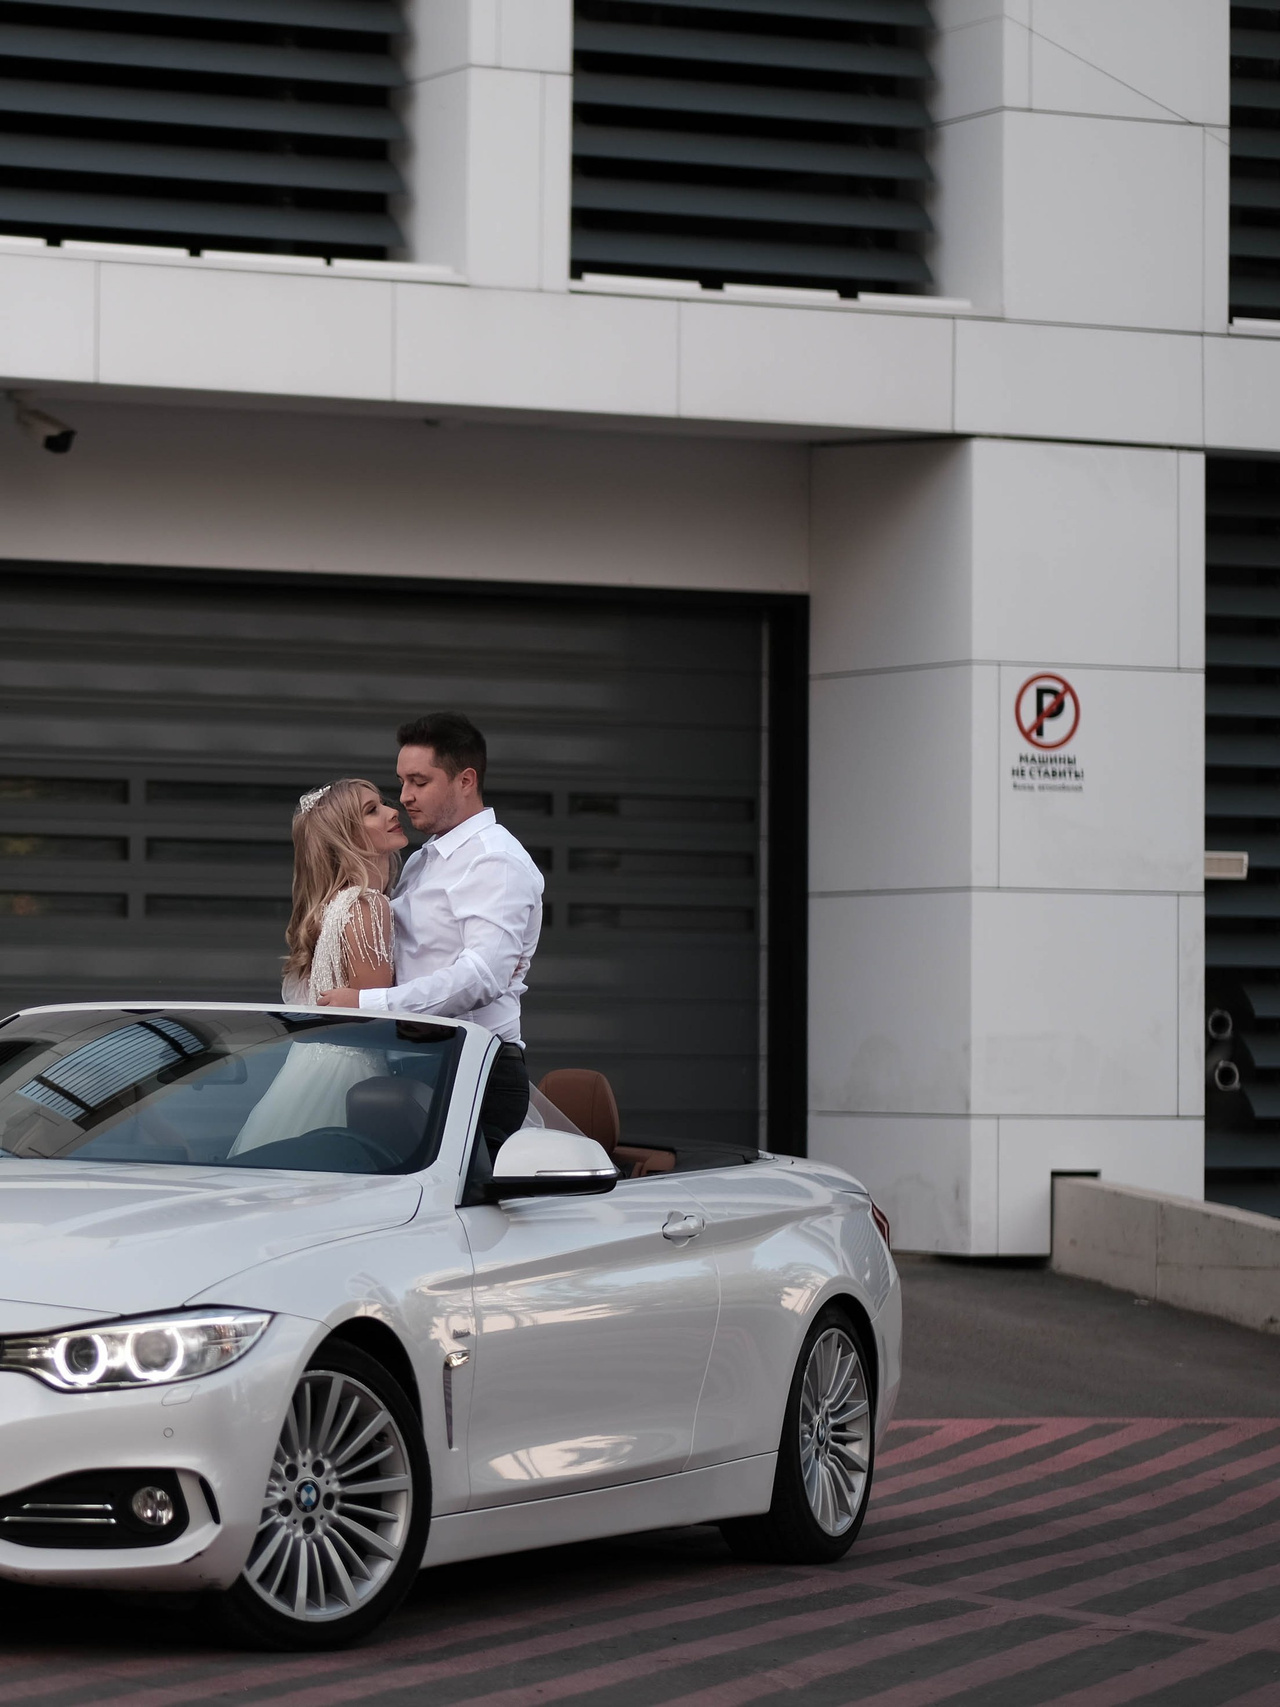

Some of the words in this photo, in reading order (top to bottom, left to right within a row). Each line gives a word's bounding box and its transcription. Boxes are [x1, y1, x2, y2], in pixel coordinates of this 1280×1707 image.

[1019, 754, 1077, 765] МАШИНЫ
[1011, 767, 1025, 778] НЕ
[1029, 767, 1084, 779] СТАВИТЬ!
